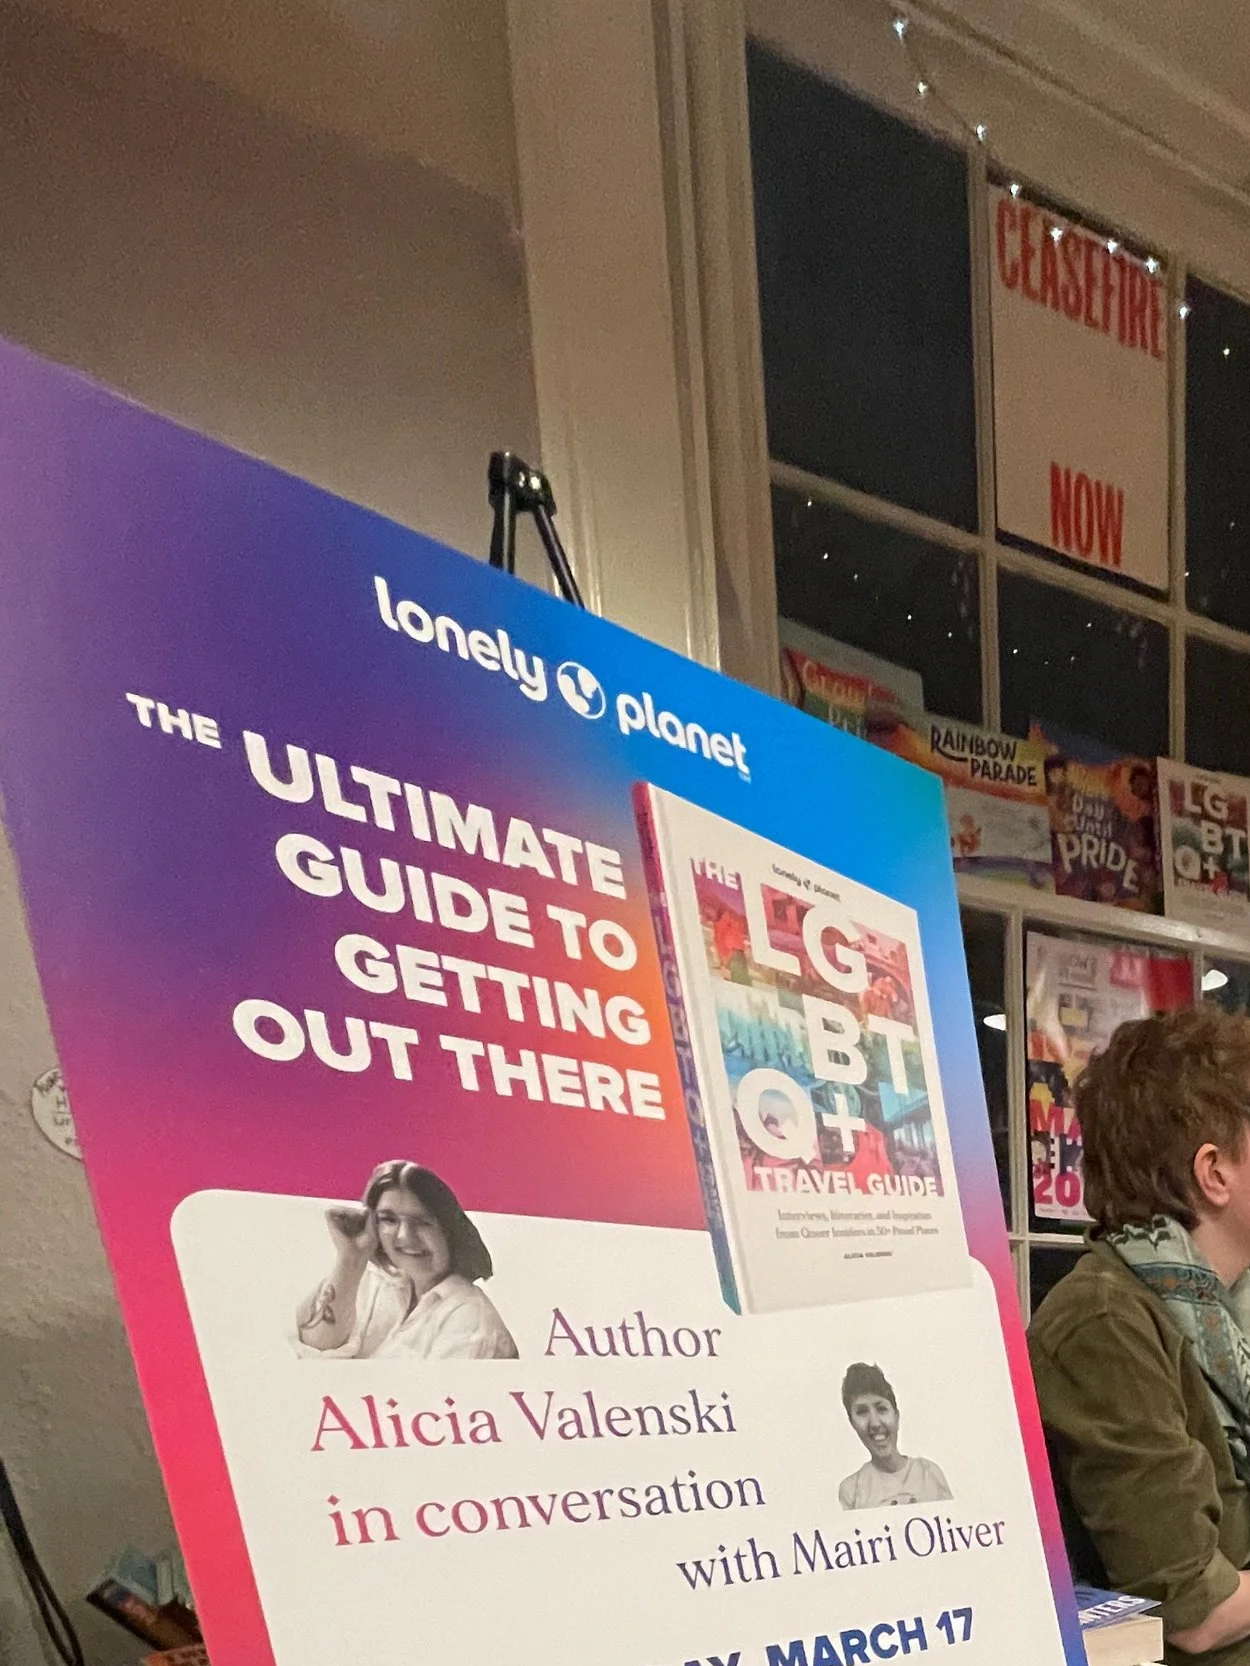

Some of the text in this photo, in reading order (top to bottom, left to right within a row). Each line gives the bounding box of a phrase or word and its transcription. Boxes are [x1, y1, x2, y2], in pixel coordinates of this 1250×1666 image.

[996, 198, 1169, 360] CEASEFIRE
[1048, 460, 1125, 568] NOW
[374, 576, 749, 775] lonely planet
[930, 725, 1018, 762] RAINBOW
[970, 758, 1038, 786] PARADE
[126, 692, 627, 899] THE ULTIMATE
[692, 858, 740, 891] THE
[1057, 832, 1138, 892] PRIDE
[275, 833, 638, 971] GUIDE TO
[334, 933, 652, 1046] GETTING
[232, 998, 667, 1121] OUT THERE
[753, 1165, 939, 1197] TRAVEL GUIDE
[545, 1307, 722, 1359] Author
[311, 1389, 738, 1452] Alicia Valenski
[327, 1470, 767, 1547] in conversation
[677, 1514, 1006, 1591] with Mairi Oliver
[935, 1606, 975, 1648] 17
